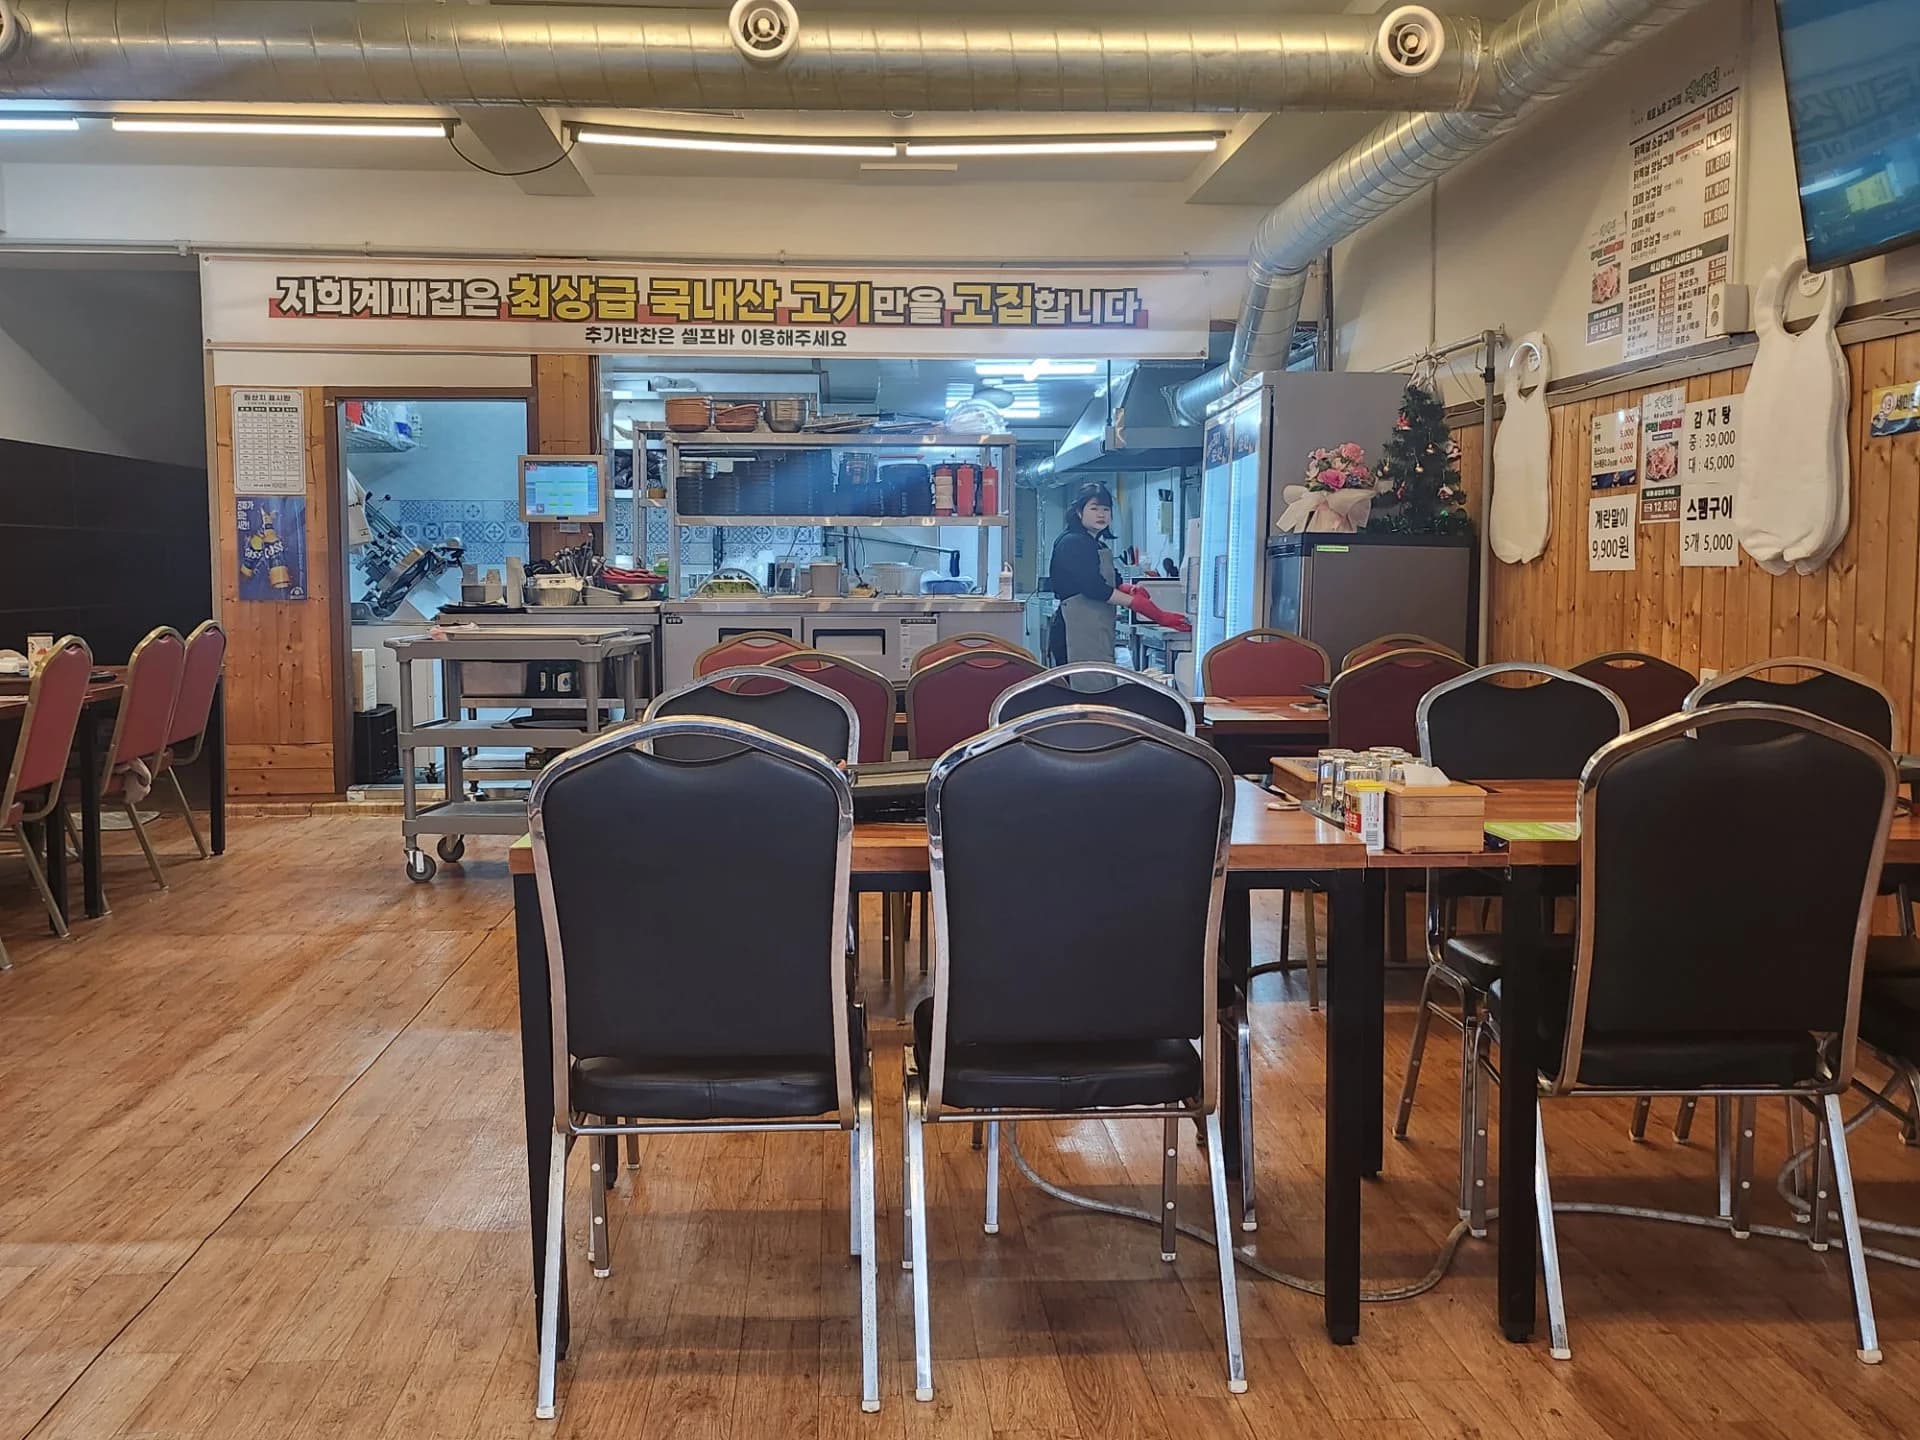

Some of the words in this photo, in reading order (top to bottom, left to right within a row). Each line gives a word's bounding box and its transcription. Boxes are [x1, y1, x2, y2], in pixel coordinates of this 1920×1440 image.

[277, 276, 499, 318] 저희계패집은
[510, 273, 638, 321] 최상급
[648, 277, 781, 323] 국내산
[789, 279, 946, 327] 고기만을
[953, 281, 1144, 328] 고집합니다
[585, 326, 675, 345] 추가반찬은
[681, 327, 734, 346] 셀프바
[741, 328, 847, 347] 이용해주세요
[1704, 430, 1736, 448] 39,000
[1688, 456, 1696, 473] 대
[1703, 454, 1735, 472] 45,000
[1595, 507, 1629, 529] 계란말이
[1686, 495, 1734, 521] 스팸구이
[1592, 535, 1630, 560] 9,900원
[1684, 533, 1700, 552] 5개
[1703, 533, 1734, 553] 5,000
